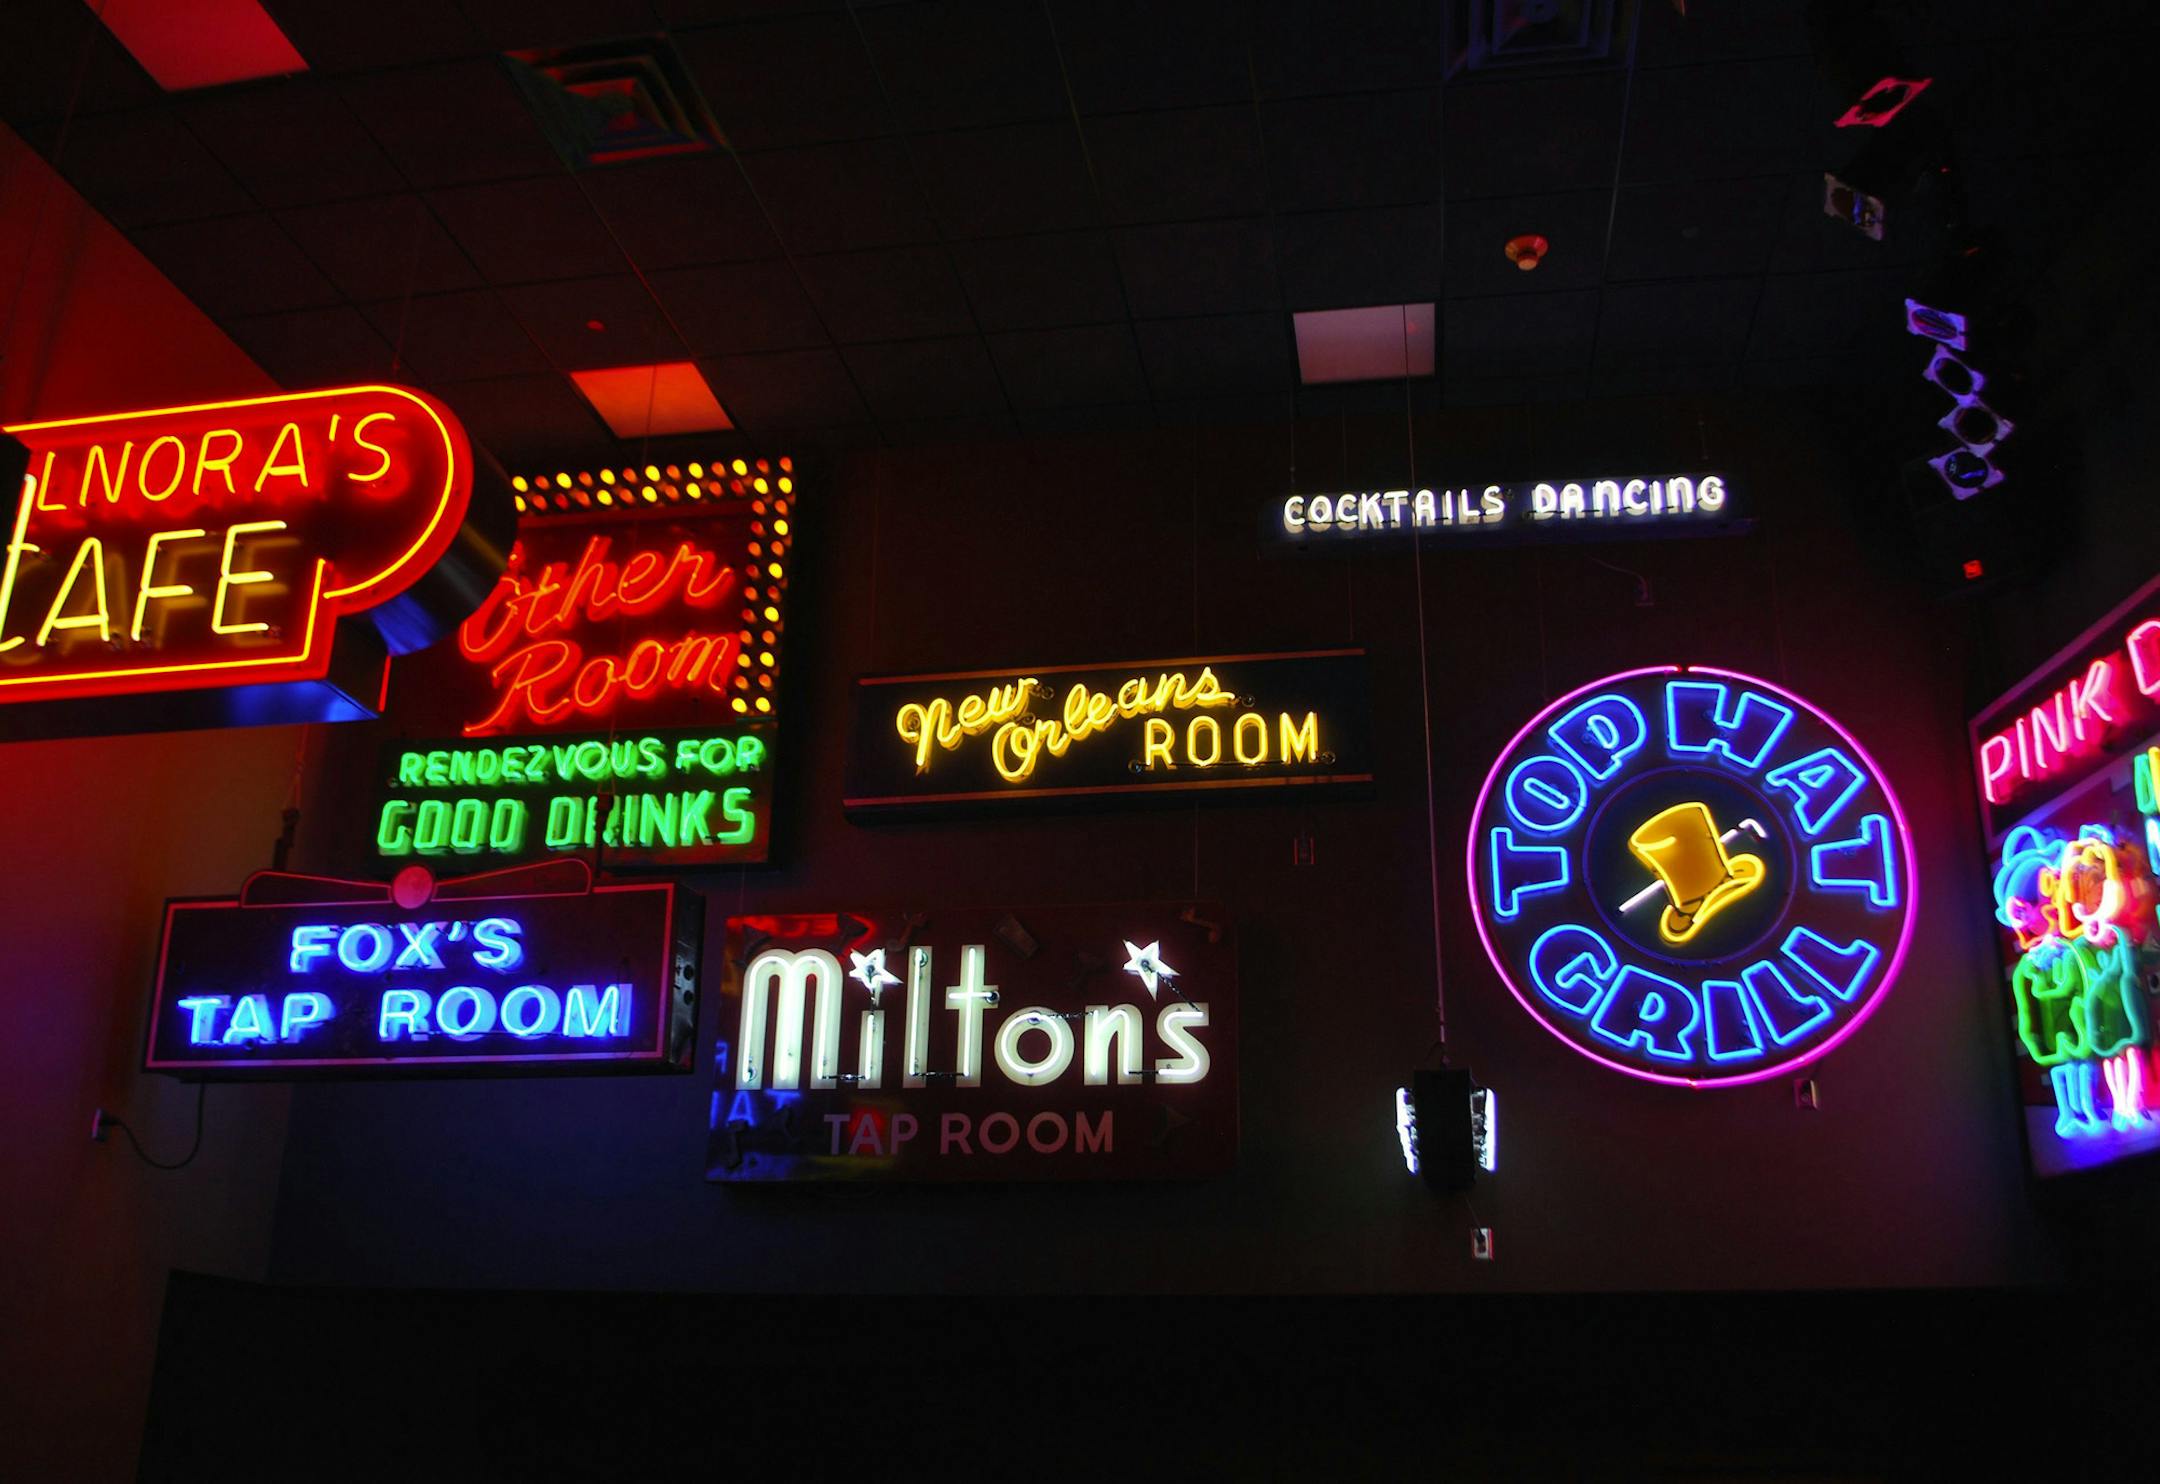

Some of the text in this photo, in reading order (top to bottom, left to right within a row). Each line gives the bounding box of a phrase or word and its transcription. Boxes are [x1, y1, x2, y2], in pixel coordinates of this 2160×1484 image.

[1284, 475, 1725, 533] COCKTAILS DANCING
[459, 535, 736, 660] Other
[461, 631, 741, 737] Room
[991, 666, 1236, 784] Orleans
[1144, 711, 1320, 770] ROOM
[400, 735, 767, 787] RENDEZVOUS FOR
[1979, 659, 2118, 805] PINK
[377, 799, 526, 856] GOOD
[1490, 694, 1648, 916] TOP
[1665, 680, 1897, 908] HAT
[289, 917, 524, 974] FOX'S
[178, 983, 633, 1045] TAP ROOM
[1528, 923, 1880, 1062] GRILL
[823, 1109, 1114, 1155] TAP ROOM
